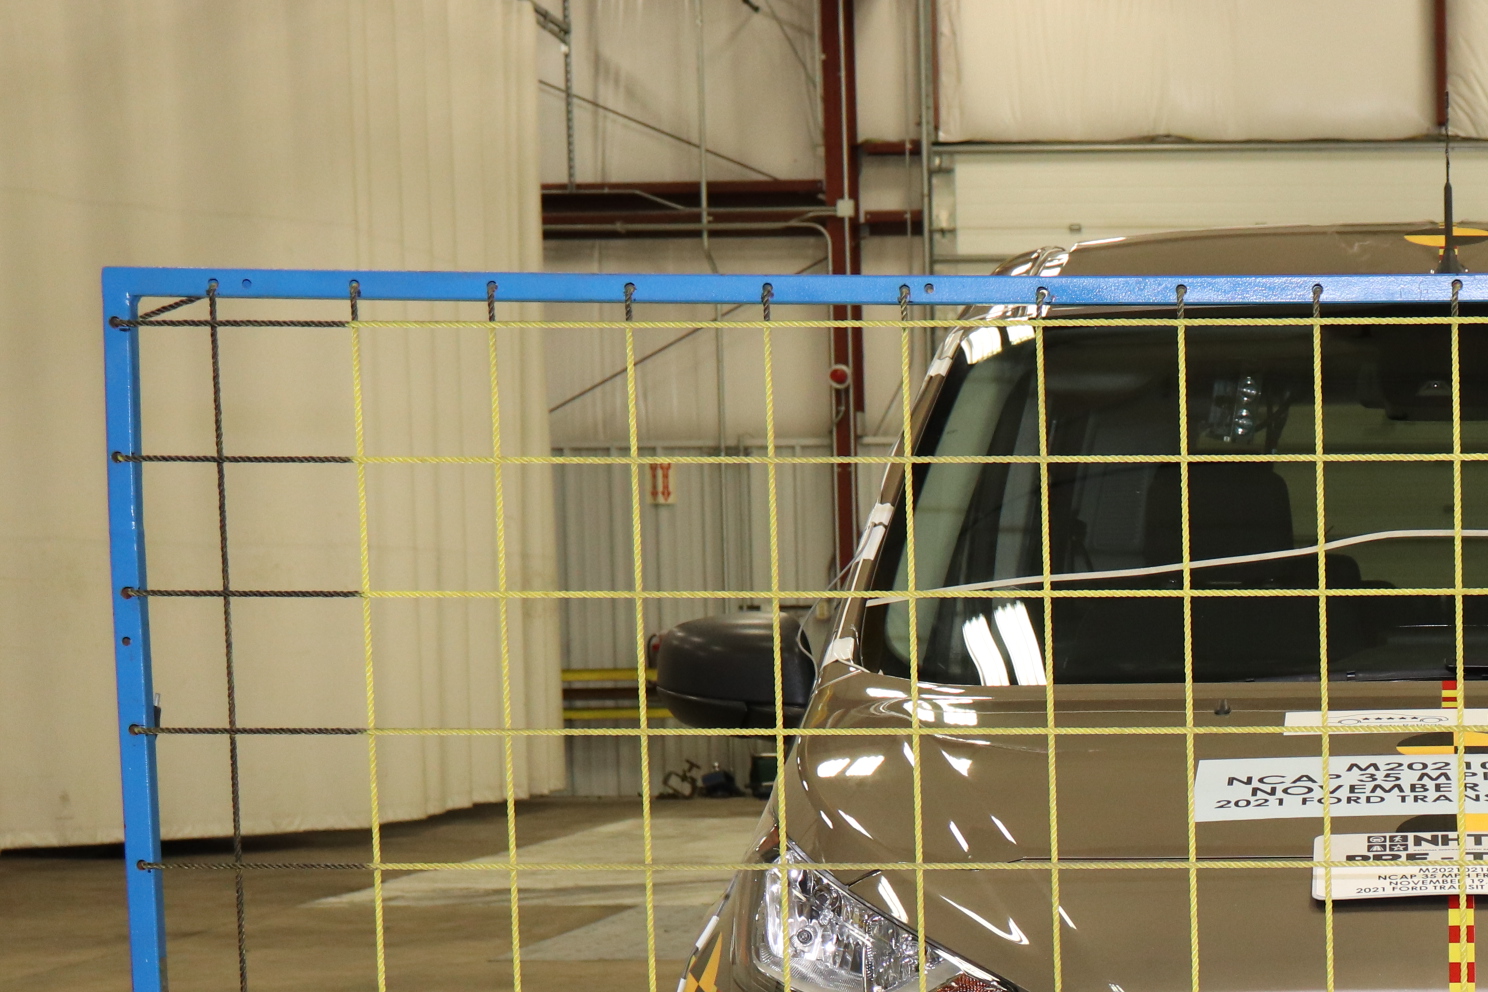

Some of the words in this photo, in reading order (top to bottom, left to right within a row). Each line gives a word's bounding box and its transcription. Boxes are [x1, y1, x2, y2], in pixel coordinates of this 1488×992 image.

[1227, 773, 1342, 786] NCAP
[1357, 772, 1402, 782] 35
[1251, 782, 1480, 797] NOVEMBER
[1214, 797, 1284, 809] 2021
[1301, 795, 1386, 806] FORD
